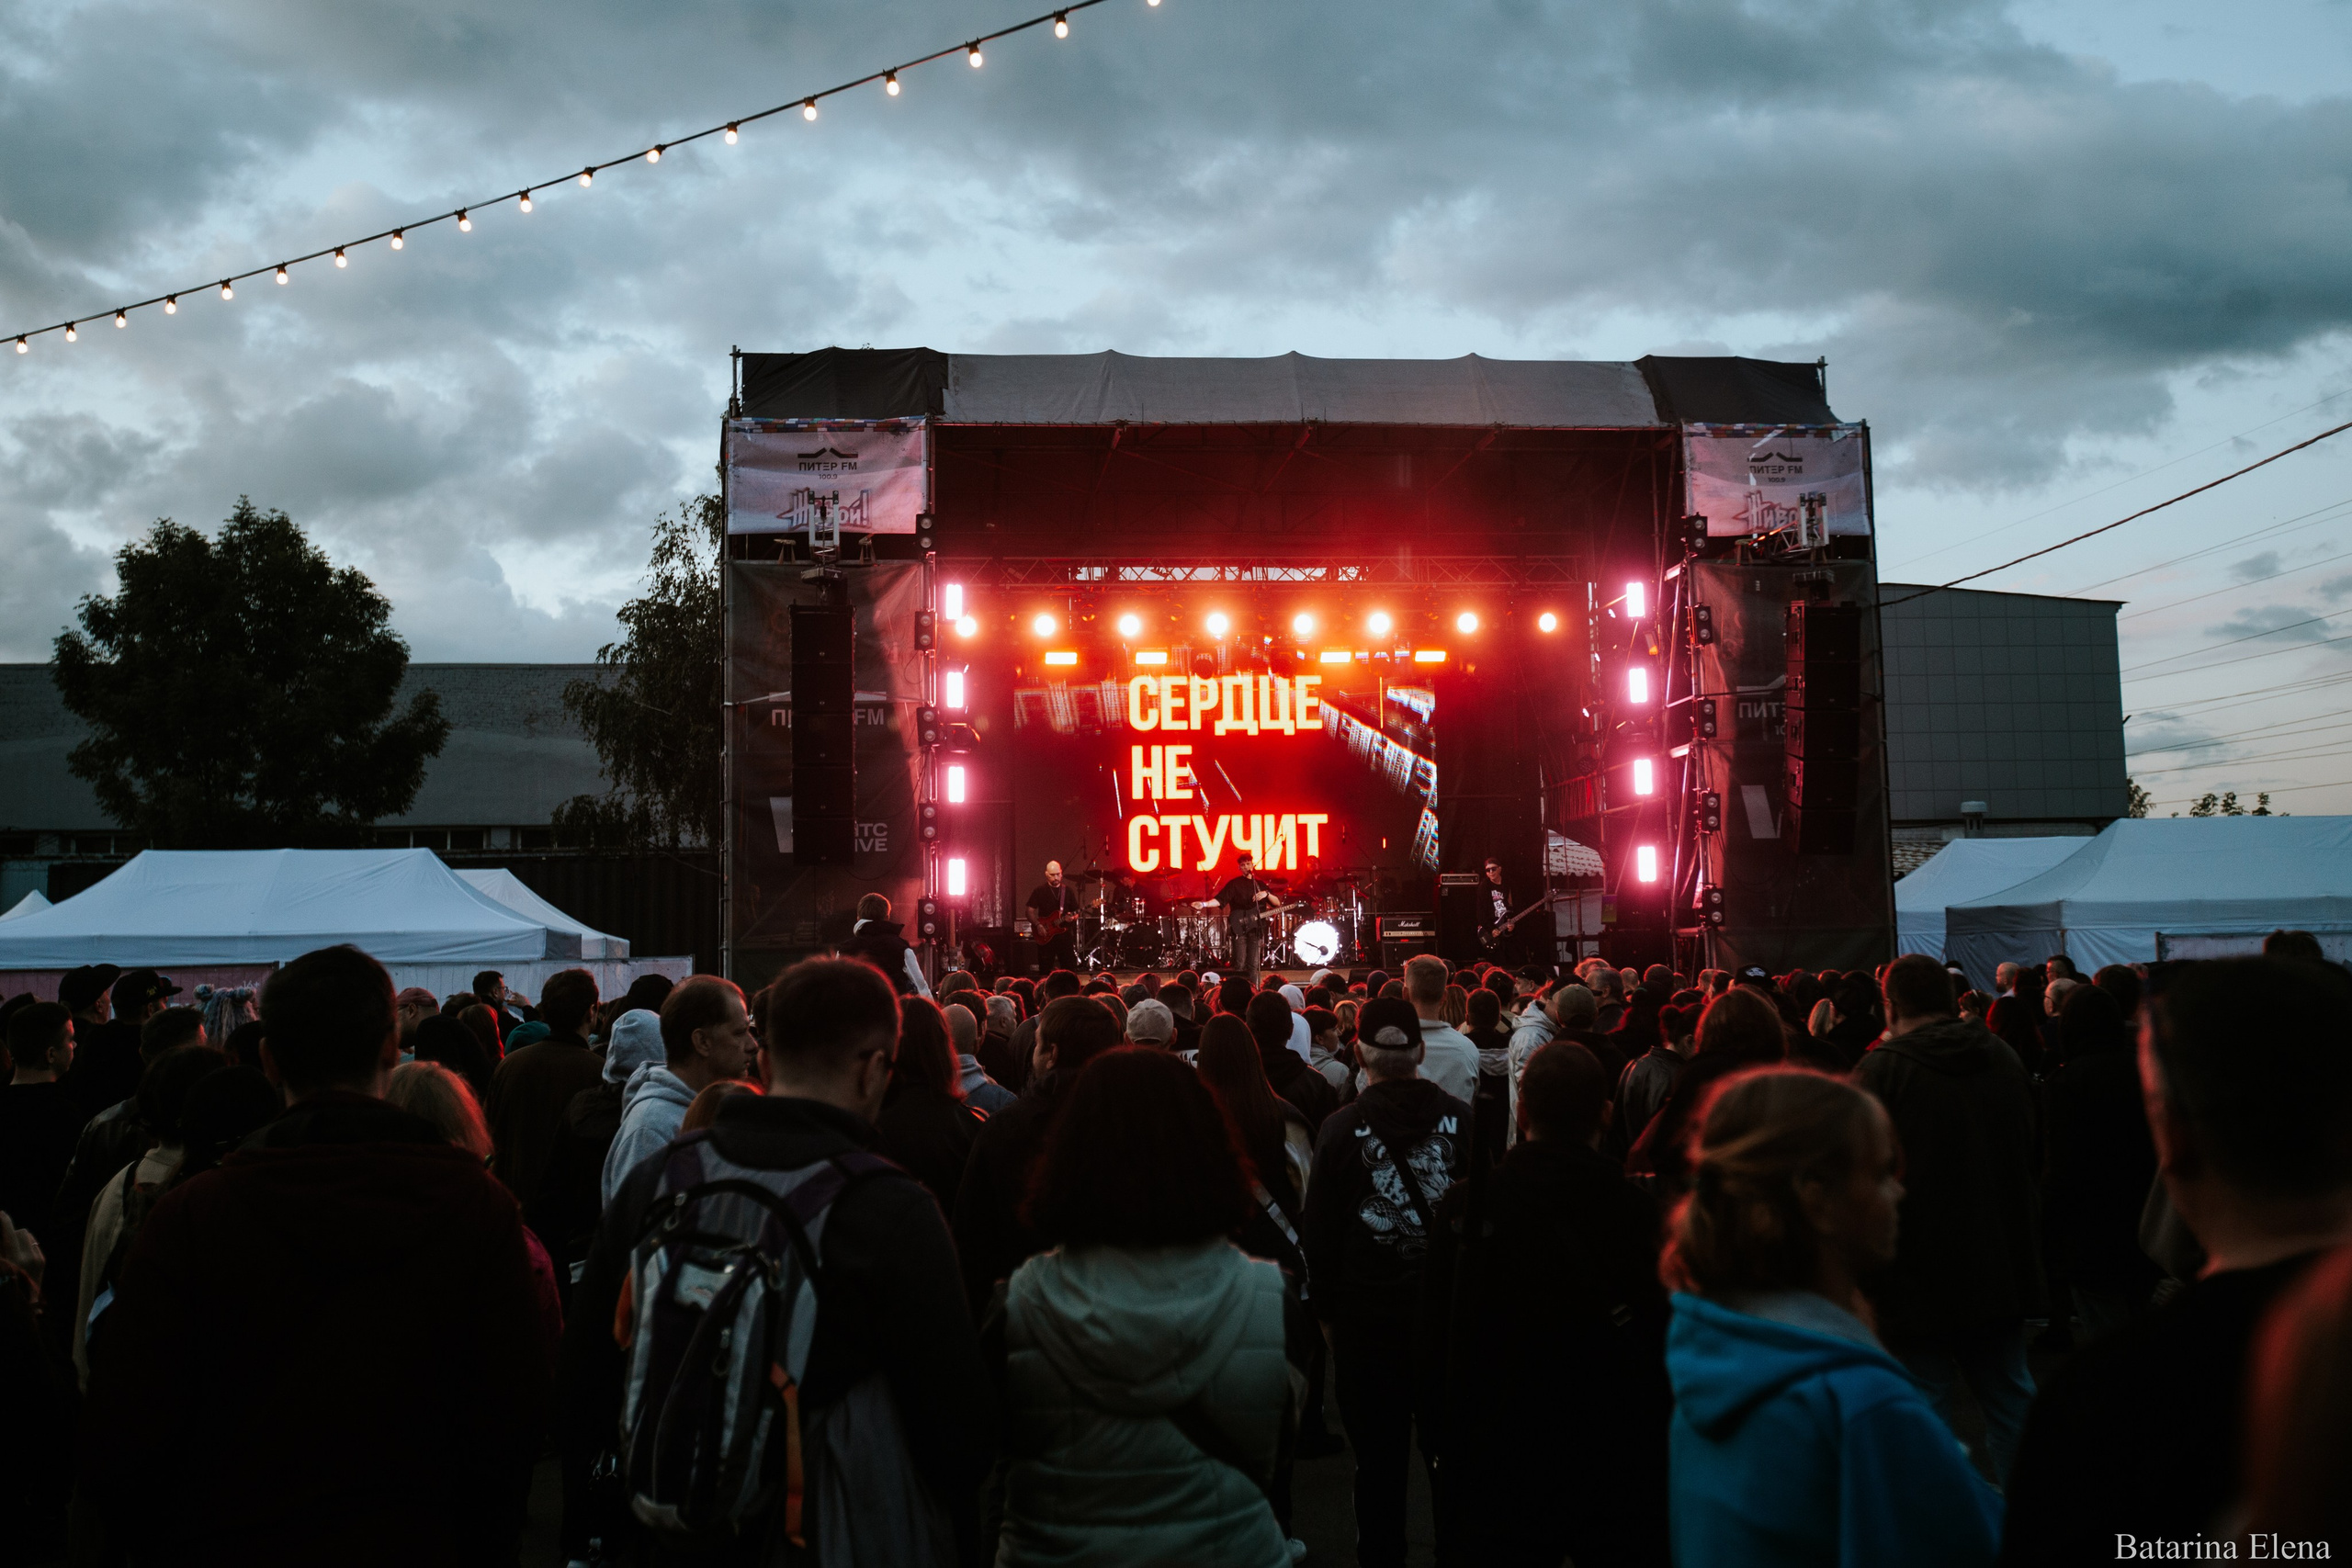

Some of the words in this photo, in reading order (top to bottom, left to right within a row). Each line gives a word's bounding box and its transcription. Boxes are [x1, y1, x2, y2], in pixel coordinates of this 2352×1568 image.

[798, 462, 838, 471] ПИТЕР
[841, 462, 857, 470] FM
[1787, 465, 1803, 474] FM
[1128, 675, 1323, 735] СЕРДЦЕ
[1738, 702, 1786, 718] ПИТ
[1131, 745, 1193, 799] НЕ
[1128, 813, 1329, 873] СТУЧИТ
